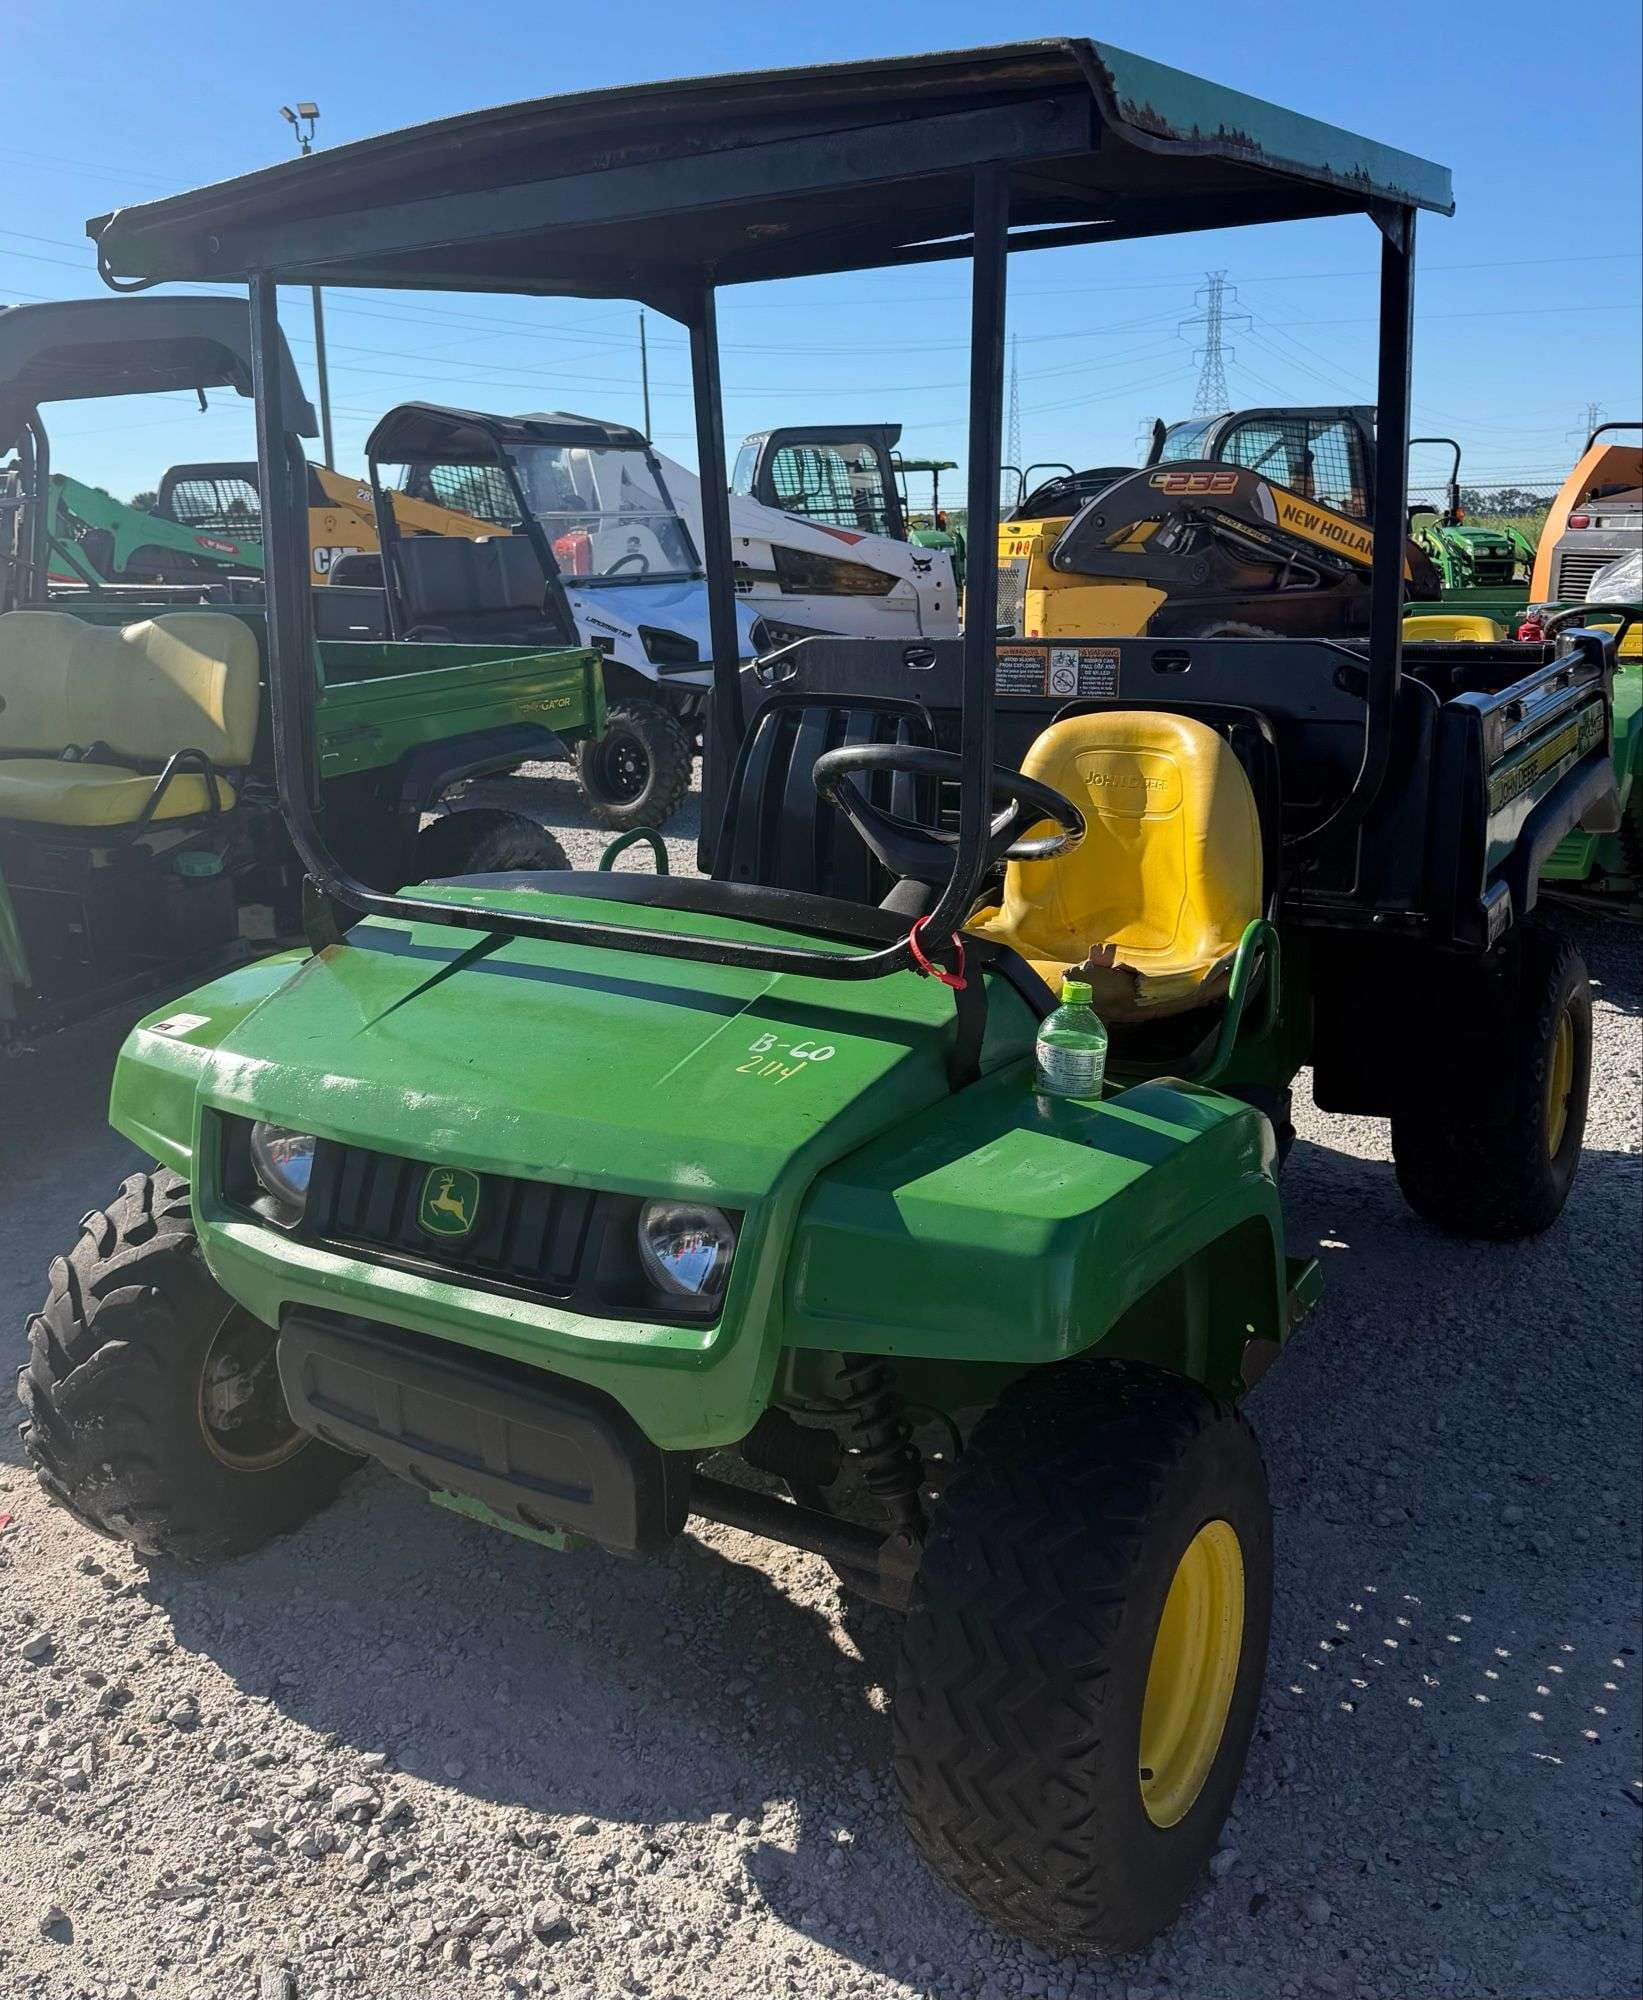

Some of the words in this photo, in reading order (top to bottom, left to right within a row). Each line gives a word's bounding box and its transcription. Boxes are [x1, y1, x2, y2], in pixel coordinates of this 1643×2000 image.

[1150, 471, 1239, 496] C232
[1282, 503, 1319, 531] NEW
[1319, 520, 1375, 556] HOLLAN
